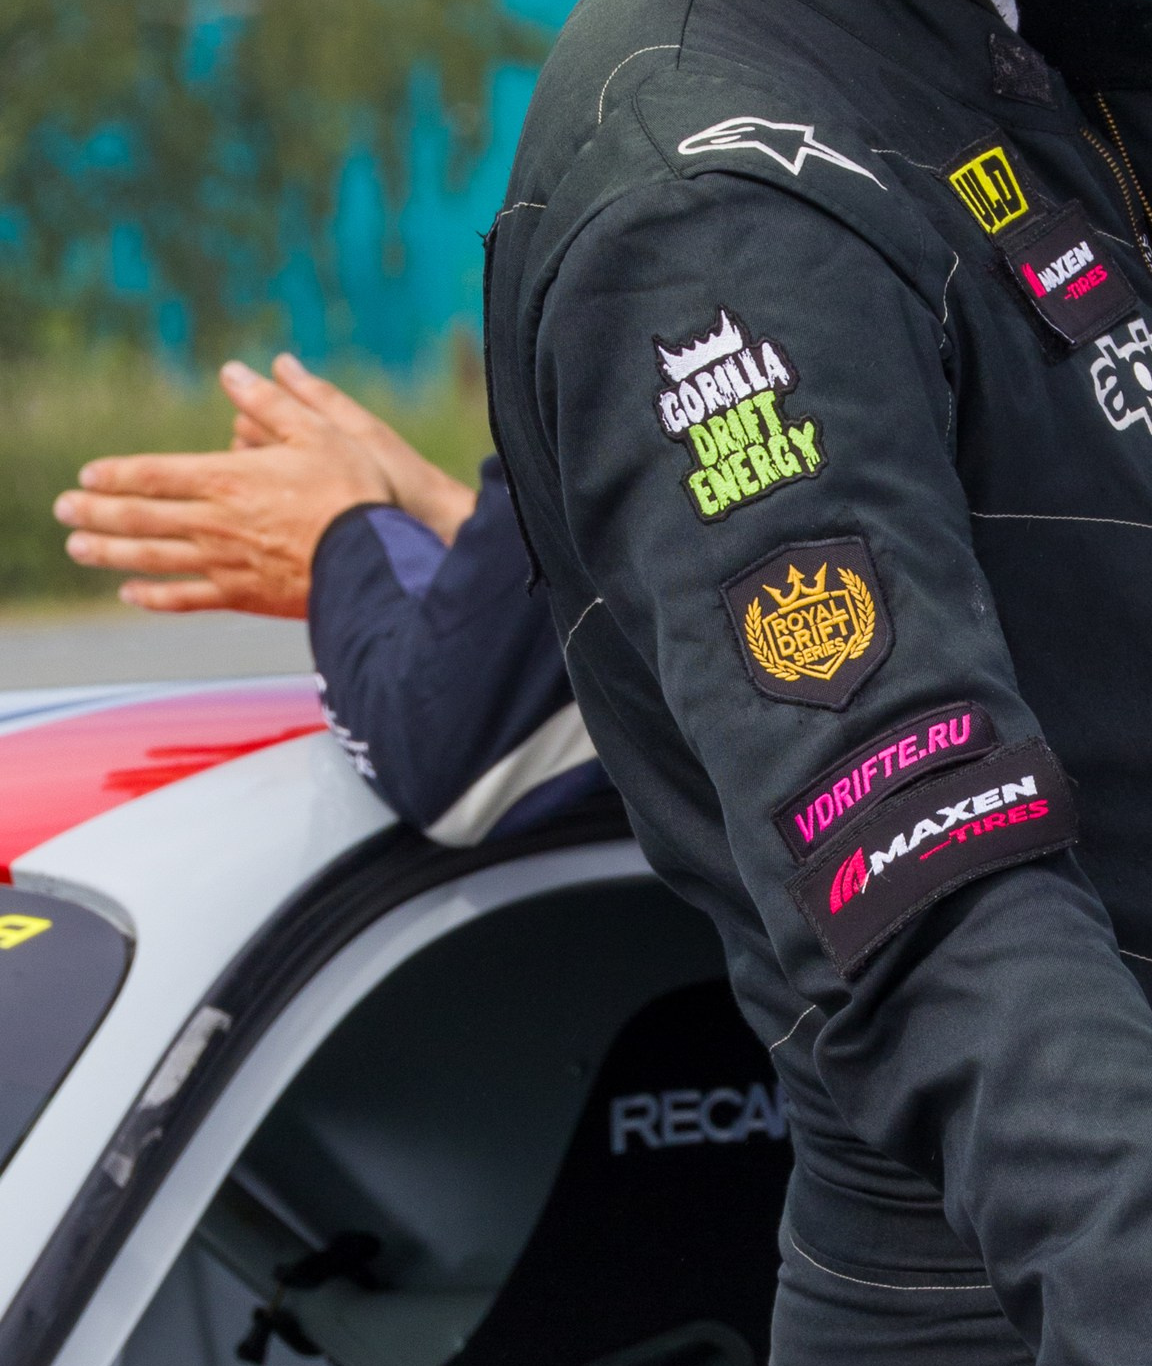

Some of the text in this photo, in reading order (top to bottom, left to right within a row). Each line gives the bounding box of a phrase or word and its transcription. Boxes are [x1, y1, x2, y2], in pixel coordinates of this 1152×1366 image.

[1036, 240, 1095, 293] MAXEN
[1067, 264, 1109, 300] TIRES
[659, 341, 791, 434] GORILLA
[687, 390, 784, 468] DRIFT
[688, 421, 822, 516] ENERGY
[770, 599, 848, 638] ROYAL
[776, 613, 850, 657] DRIFT
[793, 637, 847, 666] SERIES
[794, 713, 972, 844] VDRIFTE.RU
[868, 774, 1039, 876] MAXEN
[948, 798, 1050, 844] TIRES
[610, 1082, 786, 1156] RECA
